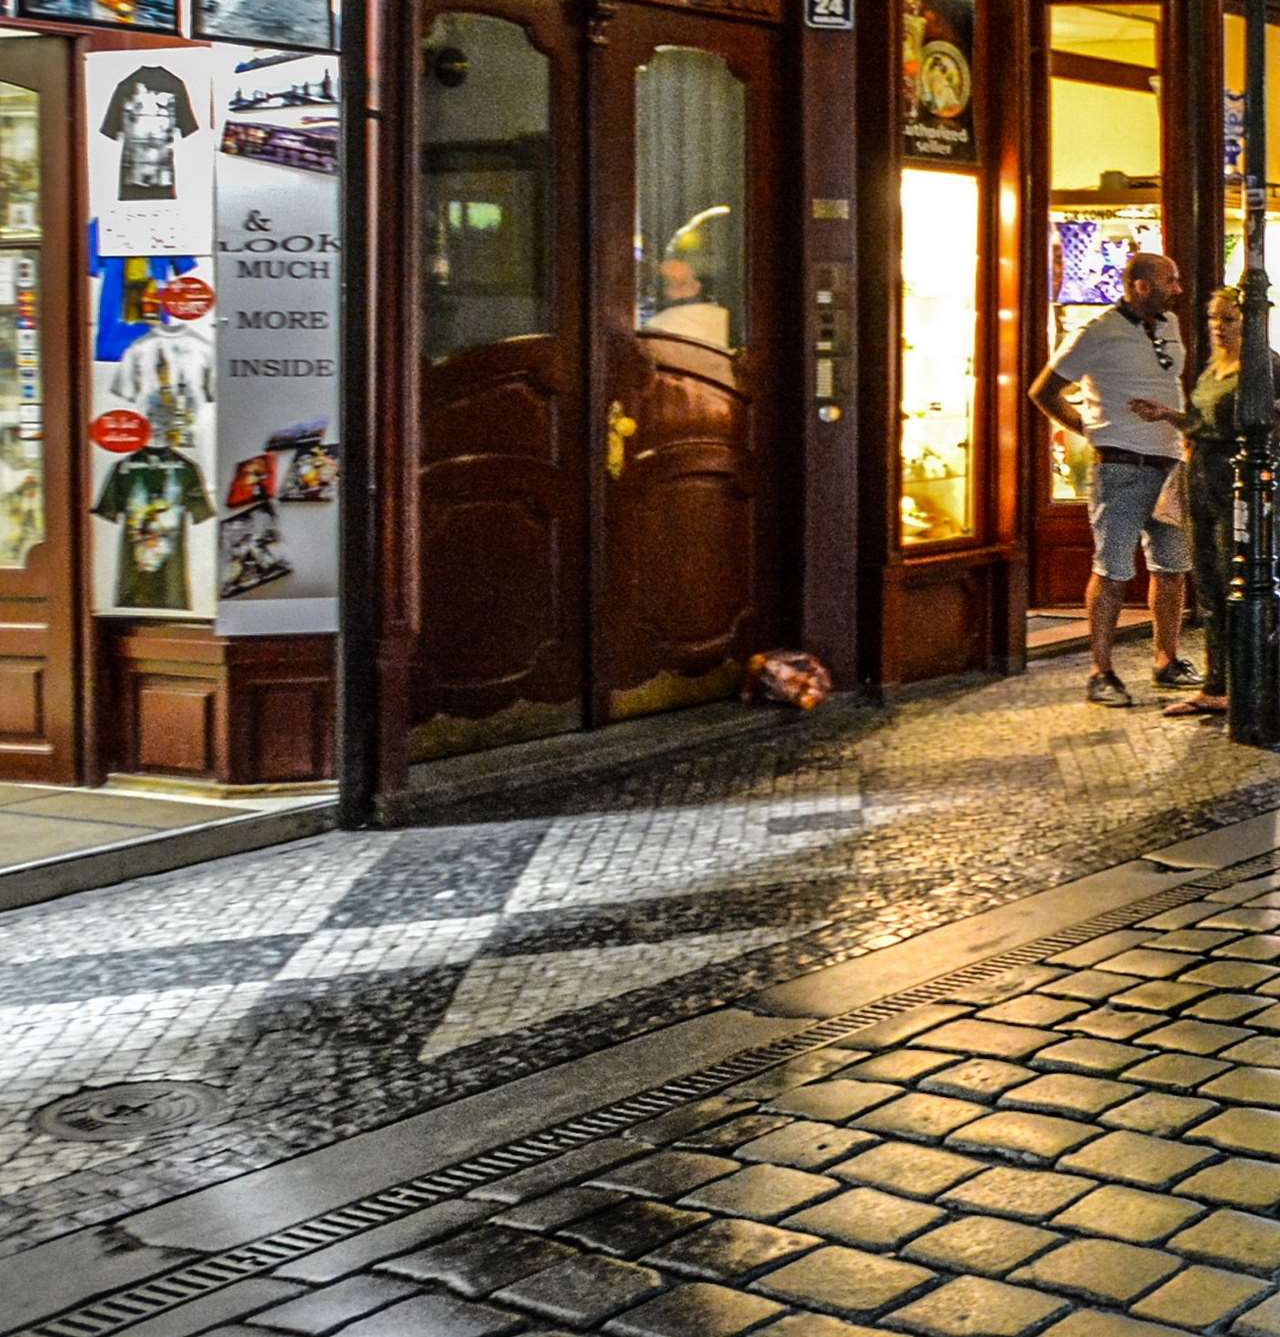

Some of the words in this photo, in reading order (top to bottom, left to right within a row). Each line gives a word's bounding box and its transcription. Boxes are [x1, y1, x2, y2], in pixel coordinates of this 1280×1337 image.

[243, 209, 272, 232] &
[218, 234, 342, 253] LOOK
[236, 260, 330, 280] MUCH
[236, 311, 329, 330] MORE
[229, 359, 336, 377] INSIDE
